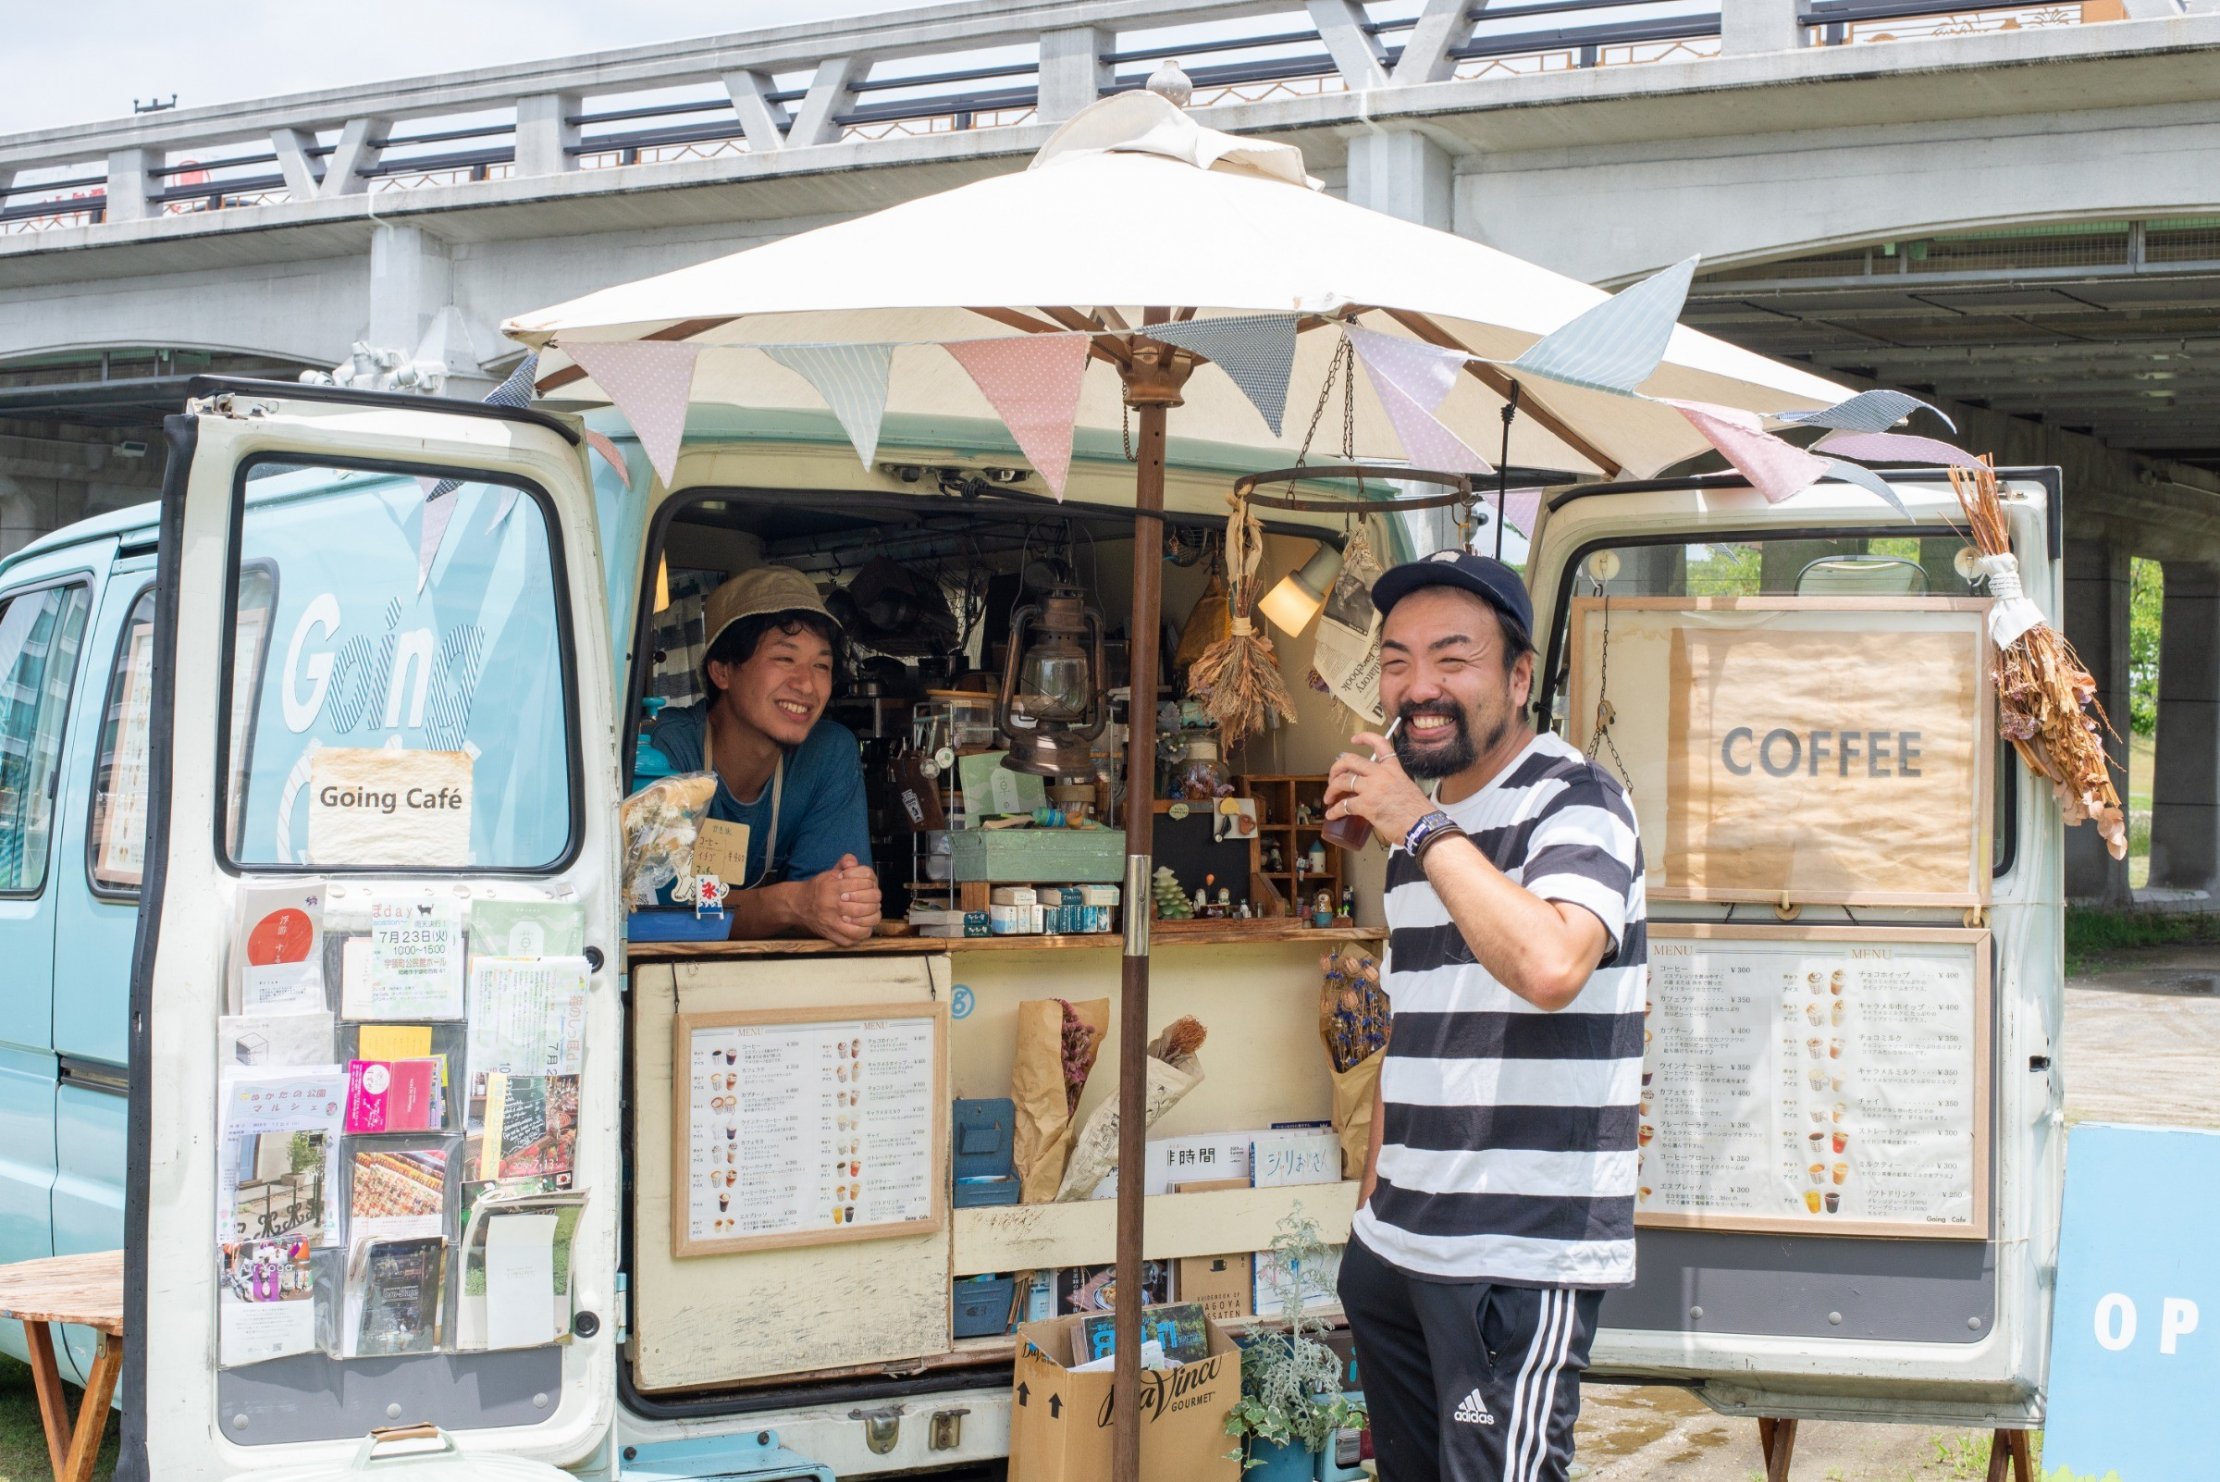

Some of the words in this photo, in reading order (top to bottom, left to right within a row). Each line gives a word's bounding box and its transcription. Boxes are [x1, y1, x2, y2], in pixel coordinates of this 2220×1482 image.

[281, 592, 486, 751] Going
[1721, 726, 1921, 778] COFFEE
[320, 786, 397, 814] Going
[406, 788, 462, 809] Café
[702, 881, 717, 899] 氷
[1654, 945, 1693, 956] MENU
[1851, 949, 1892, 960] MENU
[738, 1028, 764, 1037] MENU
[864, 1021, 888, 1031] MENU
[1171, 1392, 1212, 1413] GOURMET
[1453, 1409, 1495, 1426] adidas
